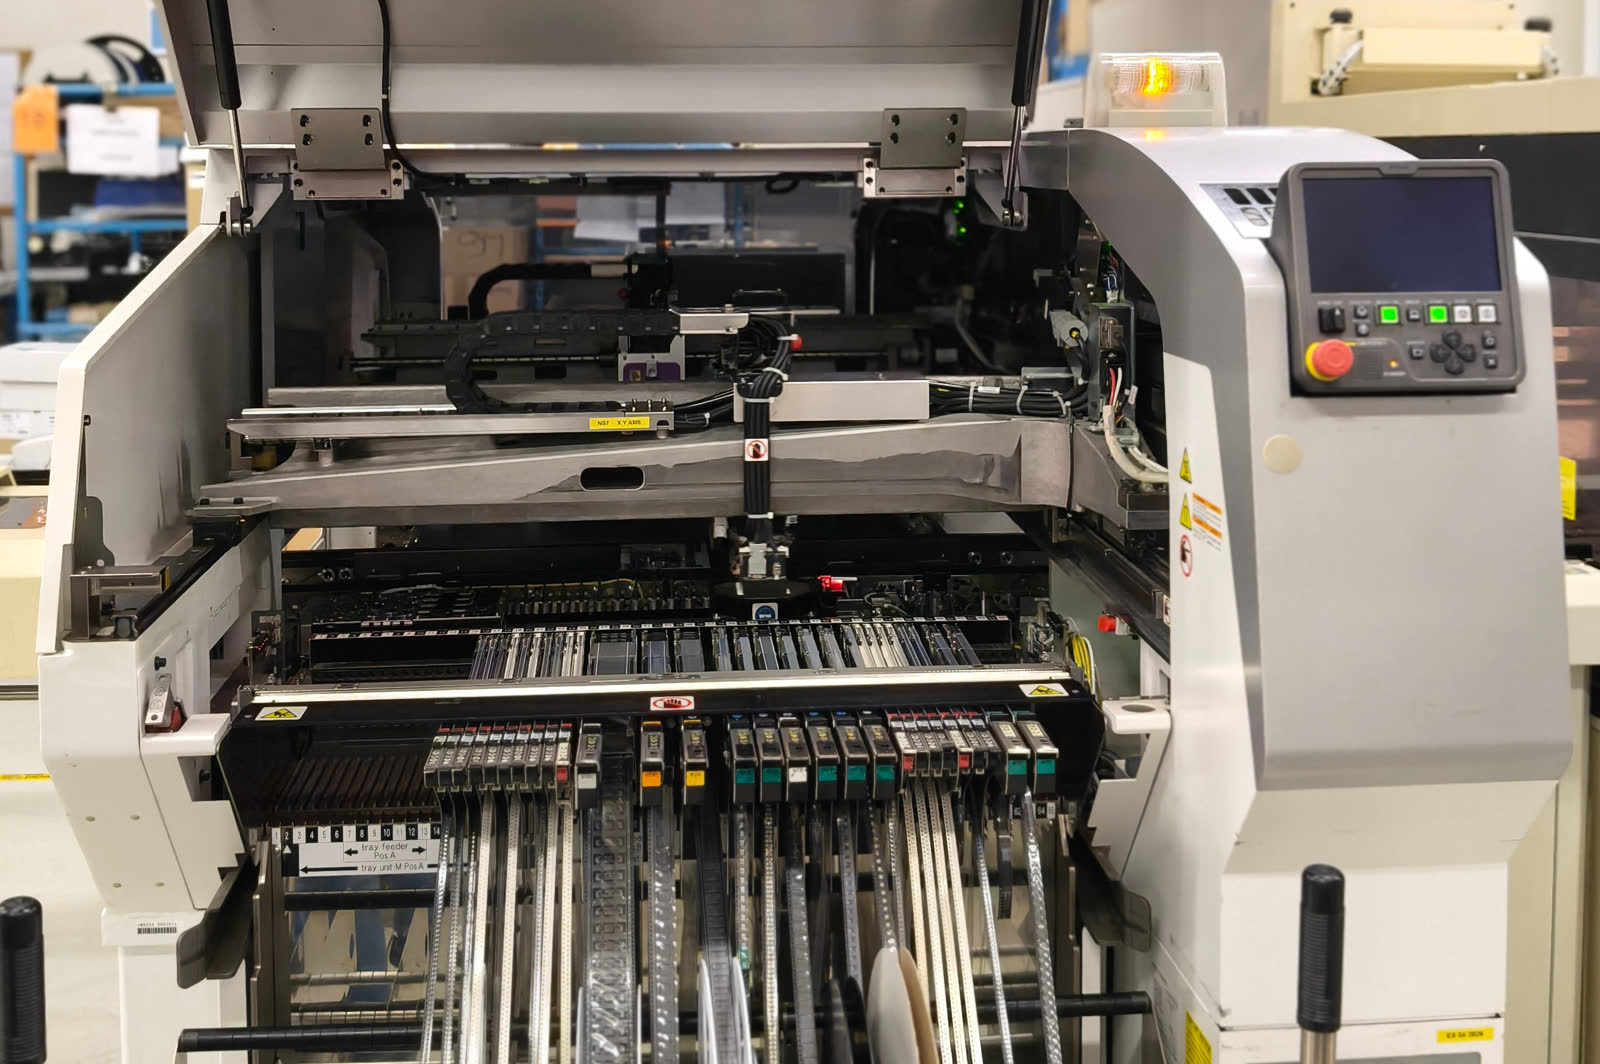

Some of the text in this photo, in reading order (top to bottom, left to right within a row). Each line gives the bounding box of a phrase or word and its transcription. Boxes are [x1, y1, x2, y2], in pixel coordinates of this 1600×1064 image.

[285, 832, 289, 840] 2
[298, 832, 302, 840] 3
[310, 830, 314, 839] 4
[322, 830, 326, 838] 5
[334, 830, 340, 838] 6
[348, 830, 352, 838] 7
[360, 830, 364, 838] 8
[372, 829, 376, 837] 9
[384, 828, 390, 837] 10
[396, 828, 402, 836] 11
[408, 828, 416, 836] 12
[422, 828, 428, 836] 13
[434, 827, 440, 835] 14
[382, 842, 408, 850] feeder
